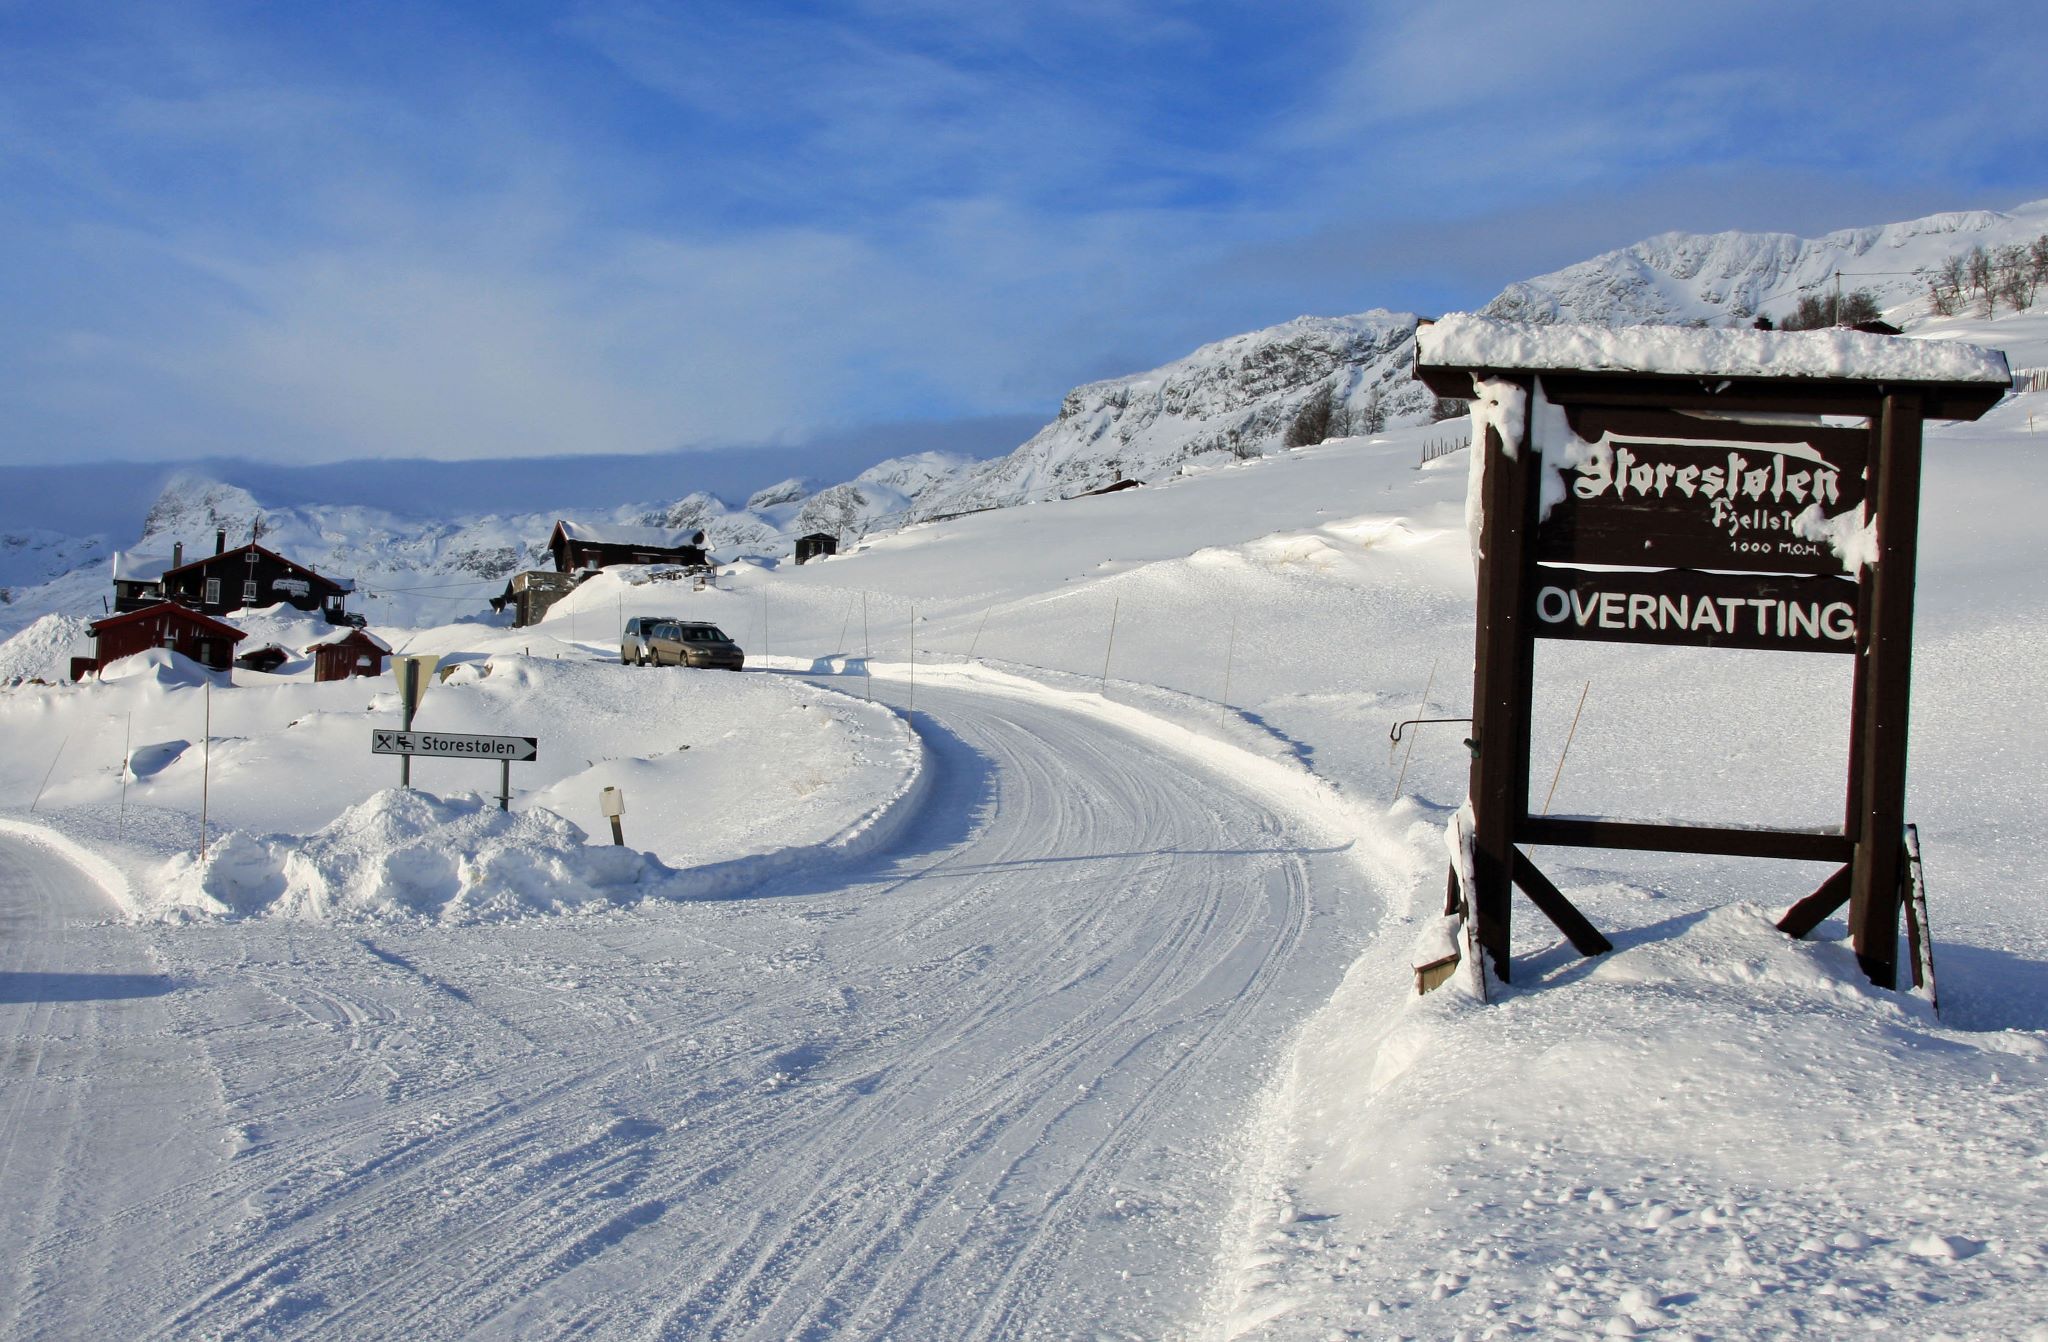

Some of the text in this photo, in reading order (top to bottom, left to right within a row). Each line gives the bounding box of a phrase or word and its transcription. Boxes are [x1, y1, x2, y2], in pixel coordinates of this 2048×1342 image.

[1573, 447, 1840, 505] Storestølen
[1710, 497, 1793, 537] Fjellst
[1730, 541, 1771, 554] 1000
[1536, 586, 1855, 640] OVERNATTING
[422, 736, 515, 754] Storestølen
